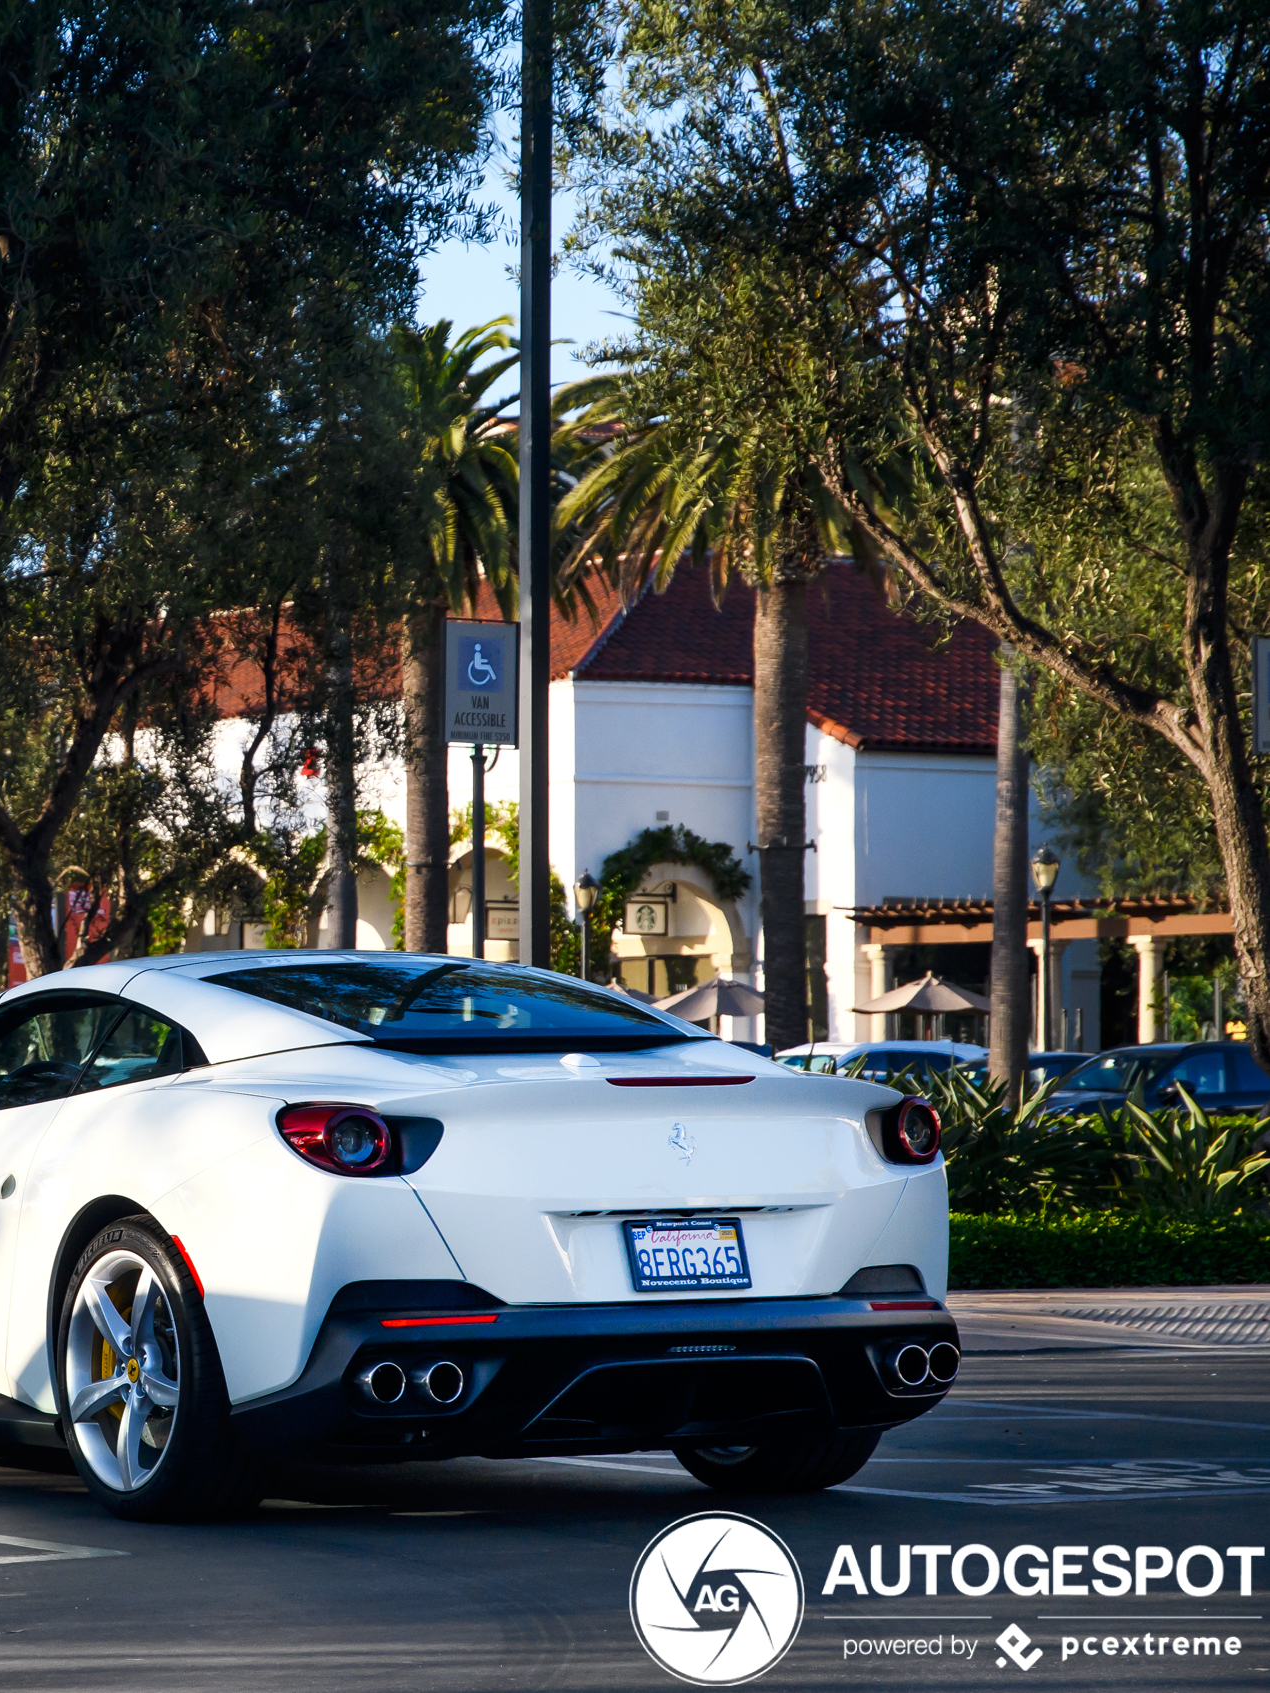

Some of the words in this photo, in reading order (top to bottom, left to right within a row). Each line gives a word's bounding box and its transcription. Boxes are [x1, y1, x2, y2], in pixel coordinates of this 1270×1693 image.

[471, 695, 490, 710] VAN
[454, 712, 506, 727] ACCESSIBLE
[450, 730, 479, 740] MINIMUM
[480, 731, 493, 741] FINE
[494, 732, 511, 742] $250
[632, 1230, 646, 1240] SEP
[651, 1230, 720, 1247] California
[76, 1229, 123, 1270] MICHELIN
[641, 1278, 697, 1287] Novecento
[700, 1277, 749, 1285] Boutique
